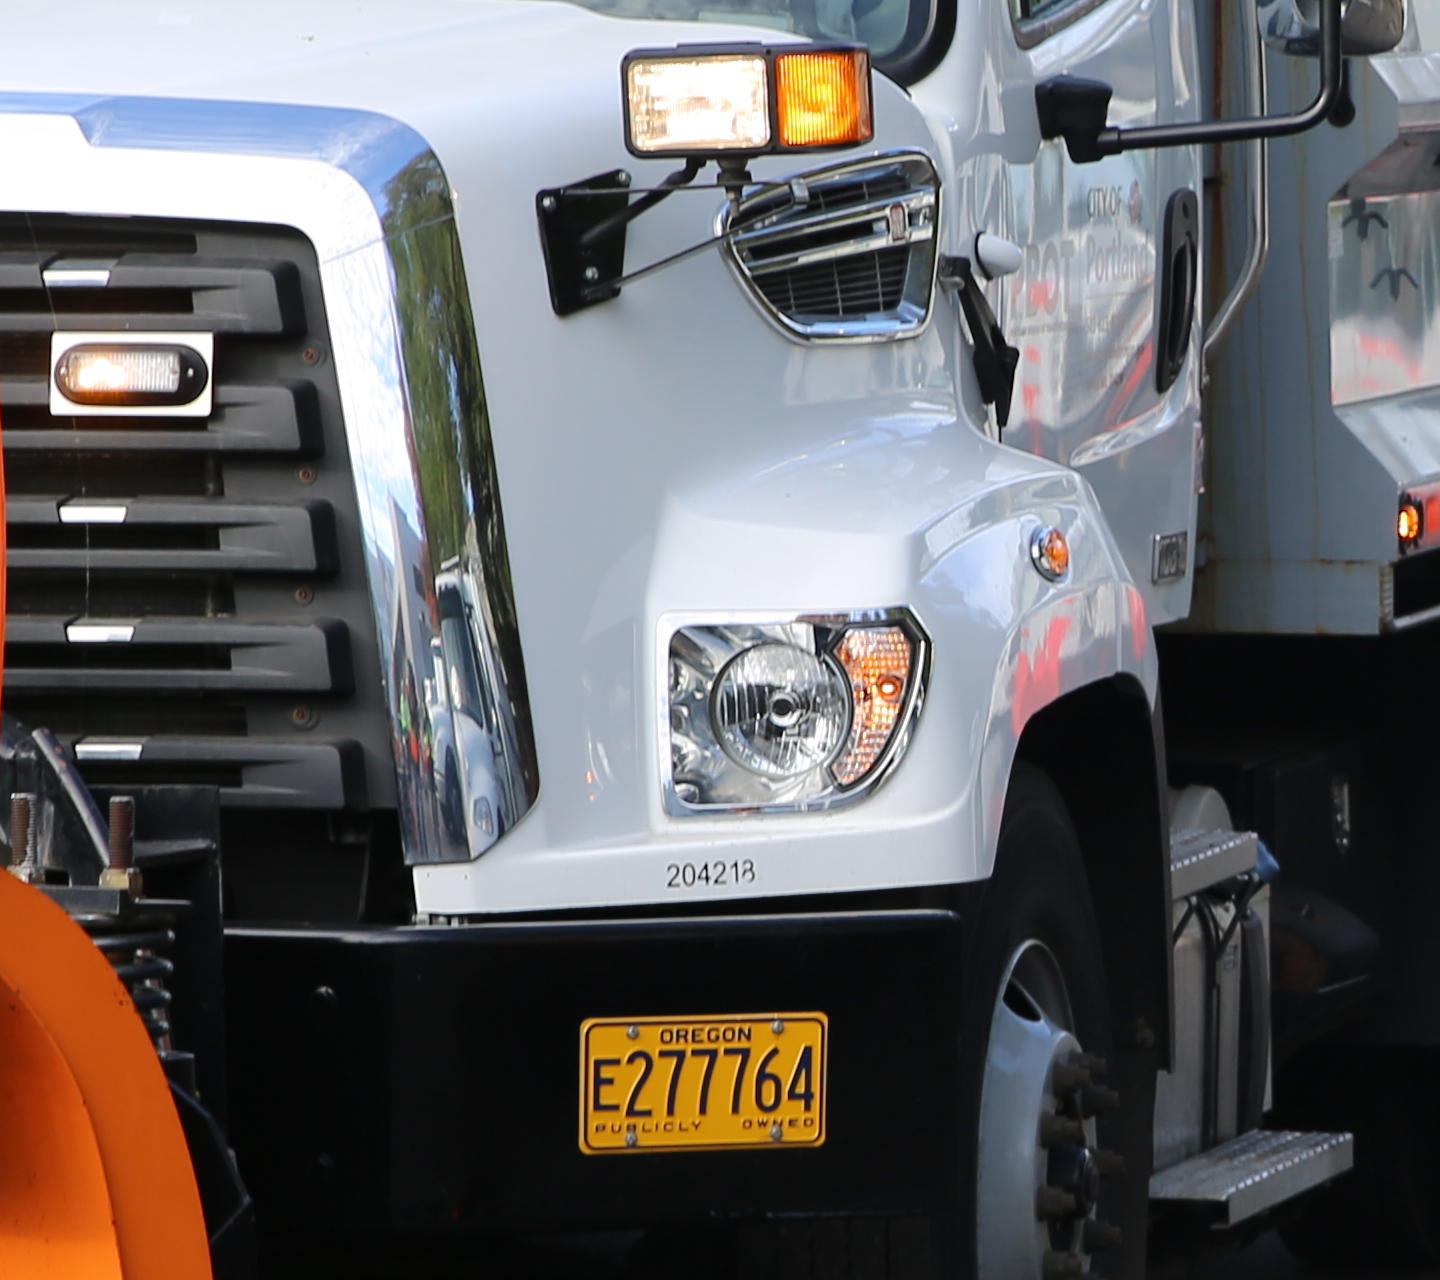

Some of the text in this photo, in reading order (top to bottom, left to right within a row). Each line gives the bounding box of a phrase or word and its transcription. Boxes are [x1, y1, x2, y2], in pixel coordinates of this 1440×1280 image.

[666, 859, 756, 889] 204218
[660, 1027, 752, 1044] OREGON
[593, 1046, 814, 1118] E277764
[595, 1121, 701, 1133] PUBLICLY
